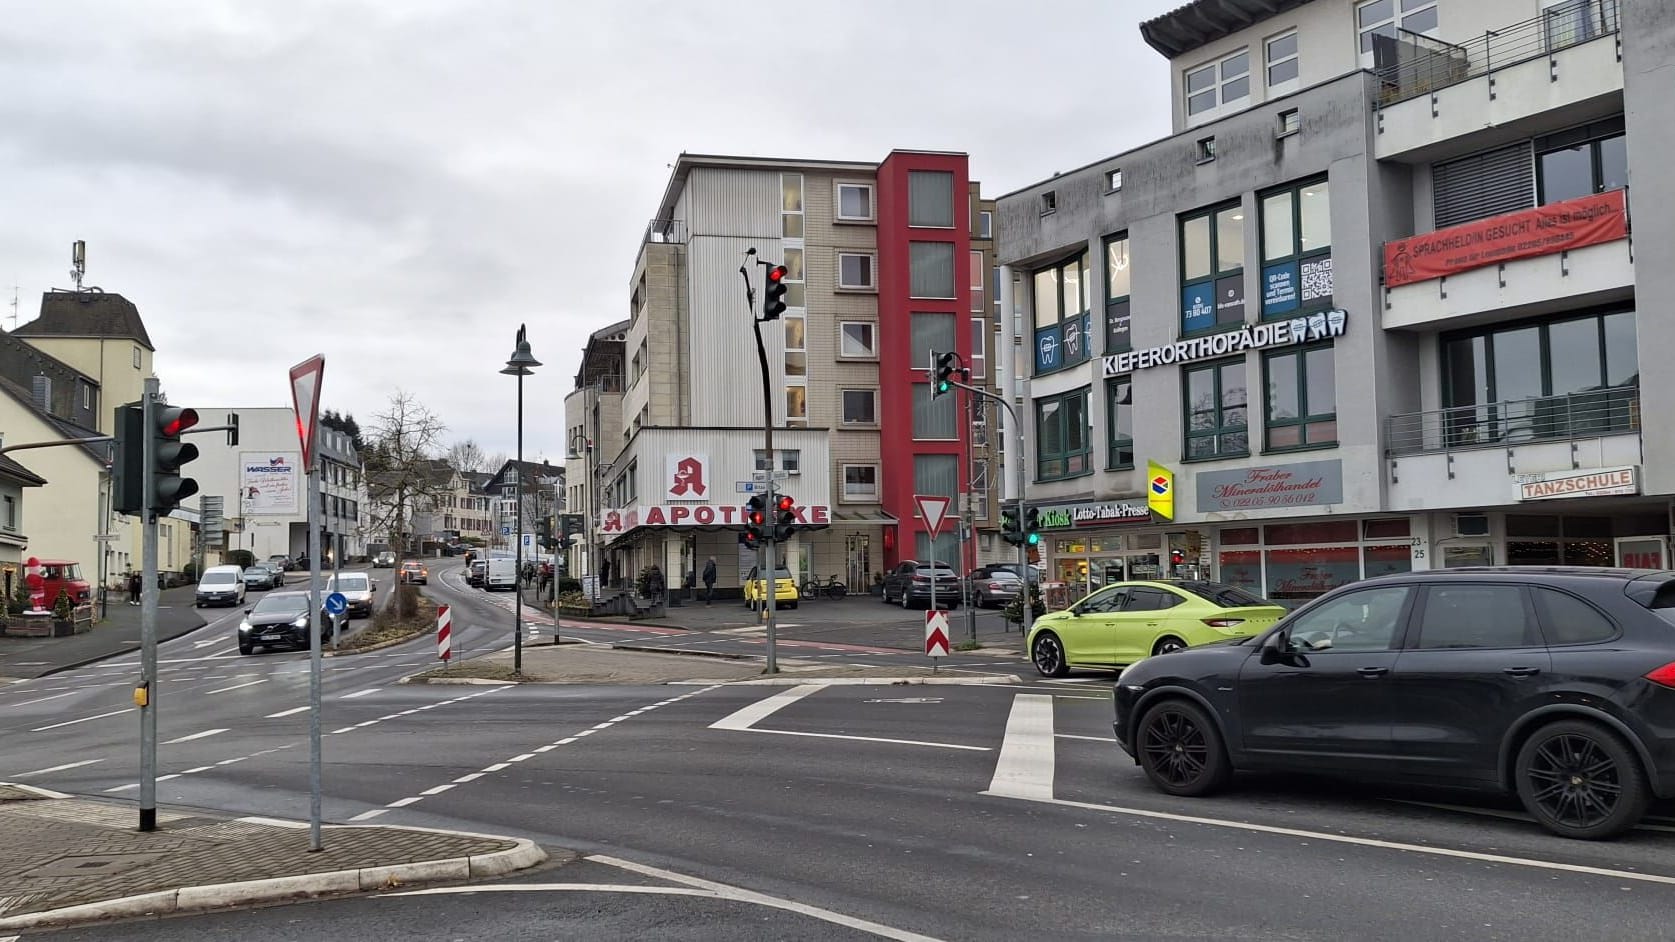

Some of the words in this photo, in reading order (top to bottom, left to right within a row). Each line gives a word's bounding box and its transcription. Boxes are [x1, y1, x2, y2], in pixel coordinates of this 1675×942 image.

[1486, 220, 1531, 241] GESUCHT
[1536, 216, 1558, 230] Alles
[1560, 212, 1571, 224] ist
[1103, 321, 1289, 374] KIEFERORTHOPÄDIE
[1244, 468, 1293, 484] Fraber
[1525, 471, 1630, 496] TANZSCHULE
[1212, 477, 1323, 499] Mineralölhandel
[646, 506, 829, 524] APOTKE
[1045, 509, 1071, 528] Kiosk
[1073, 503, 1149, 521] Lotto-Tabak-Presse
[1412, 537, 1421, 546] 23
[1415, 549, 1424, 559] 25
